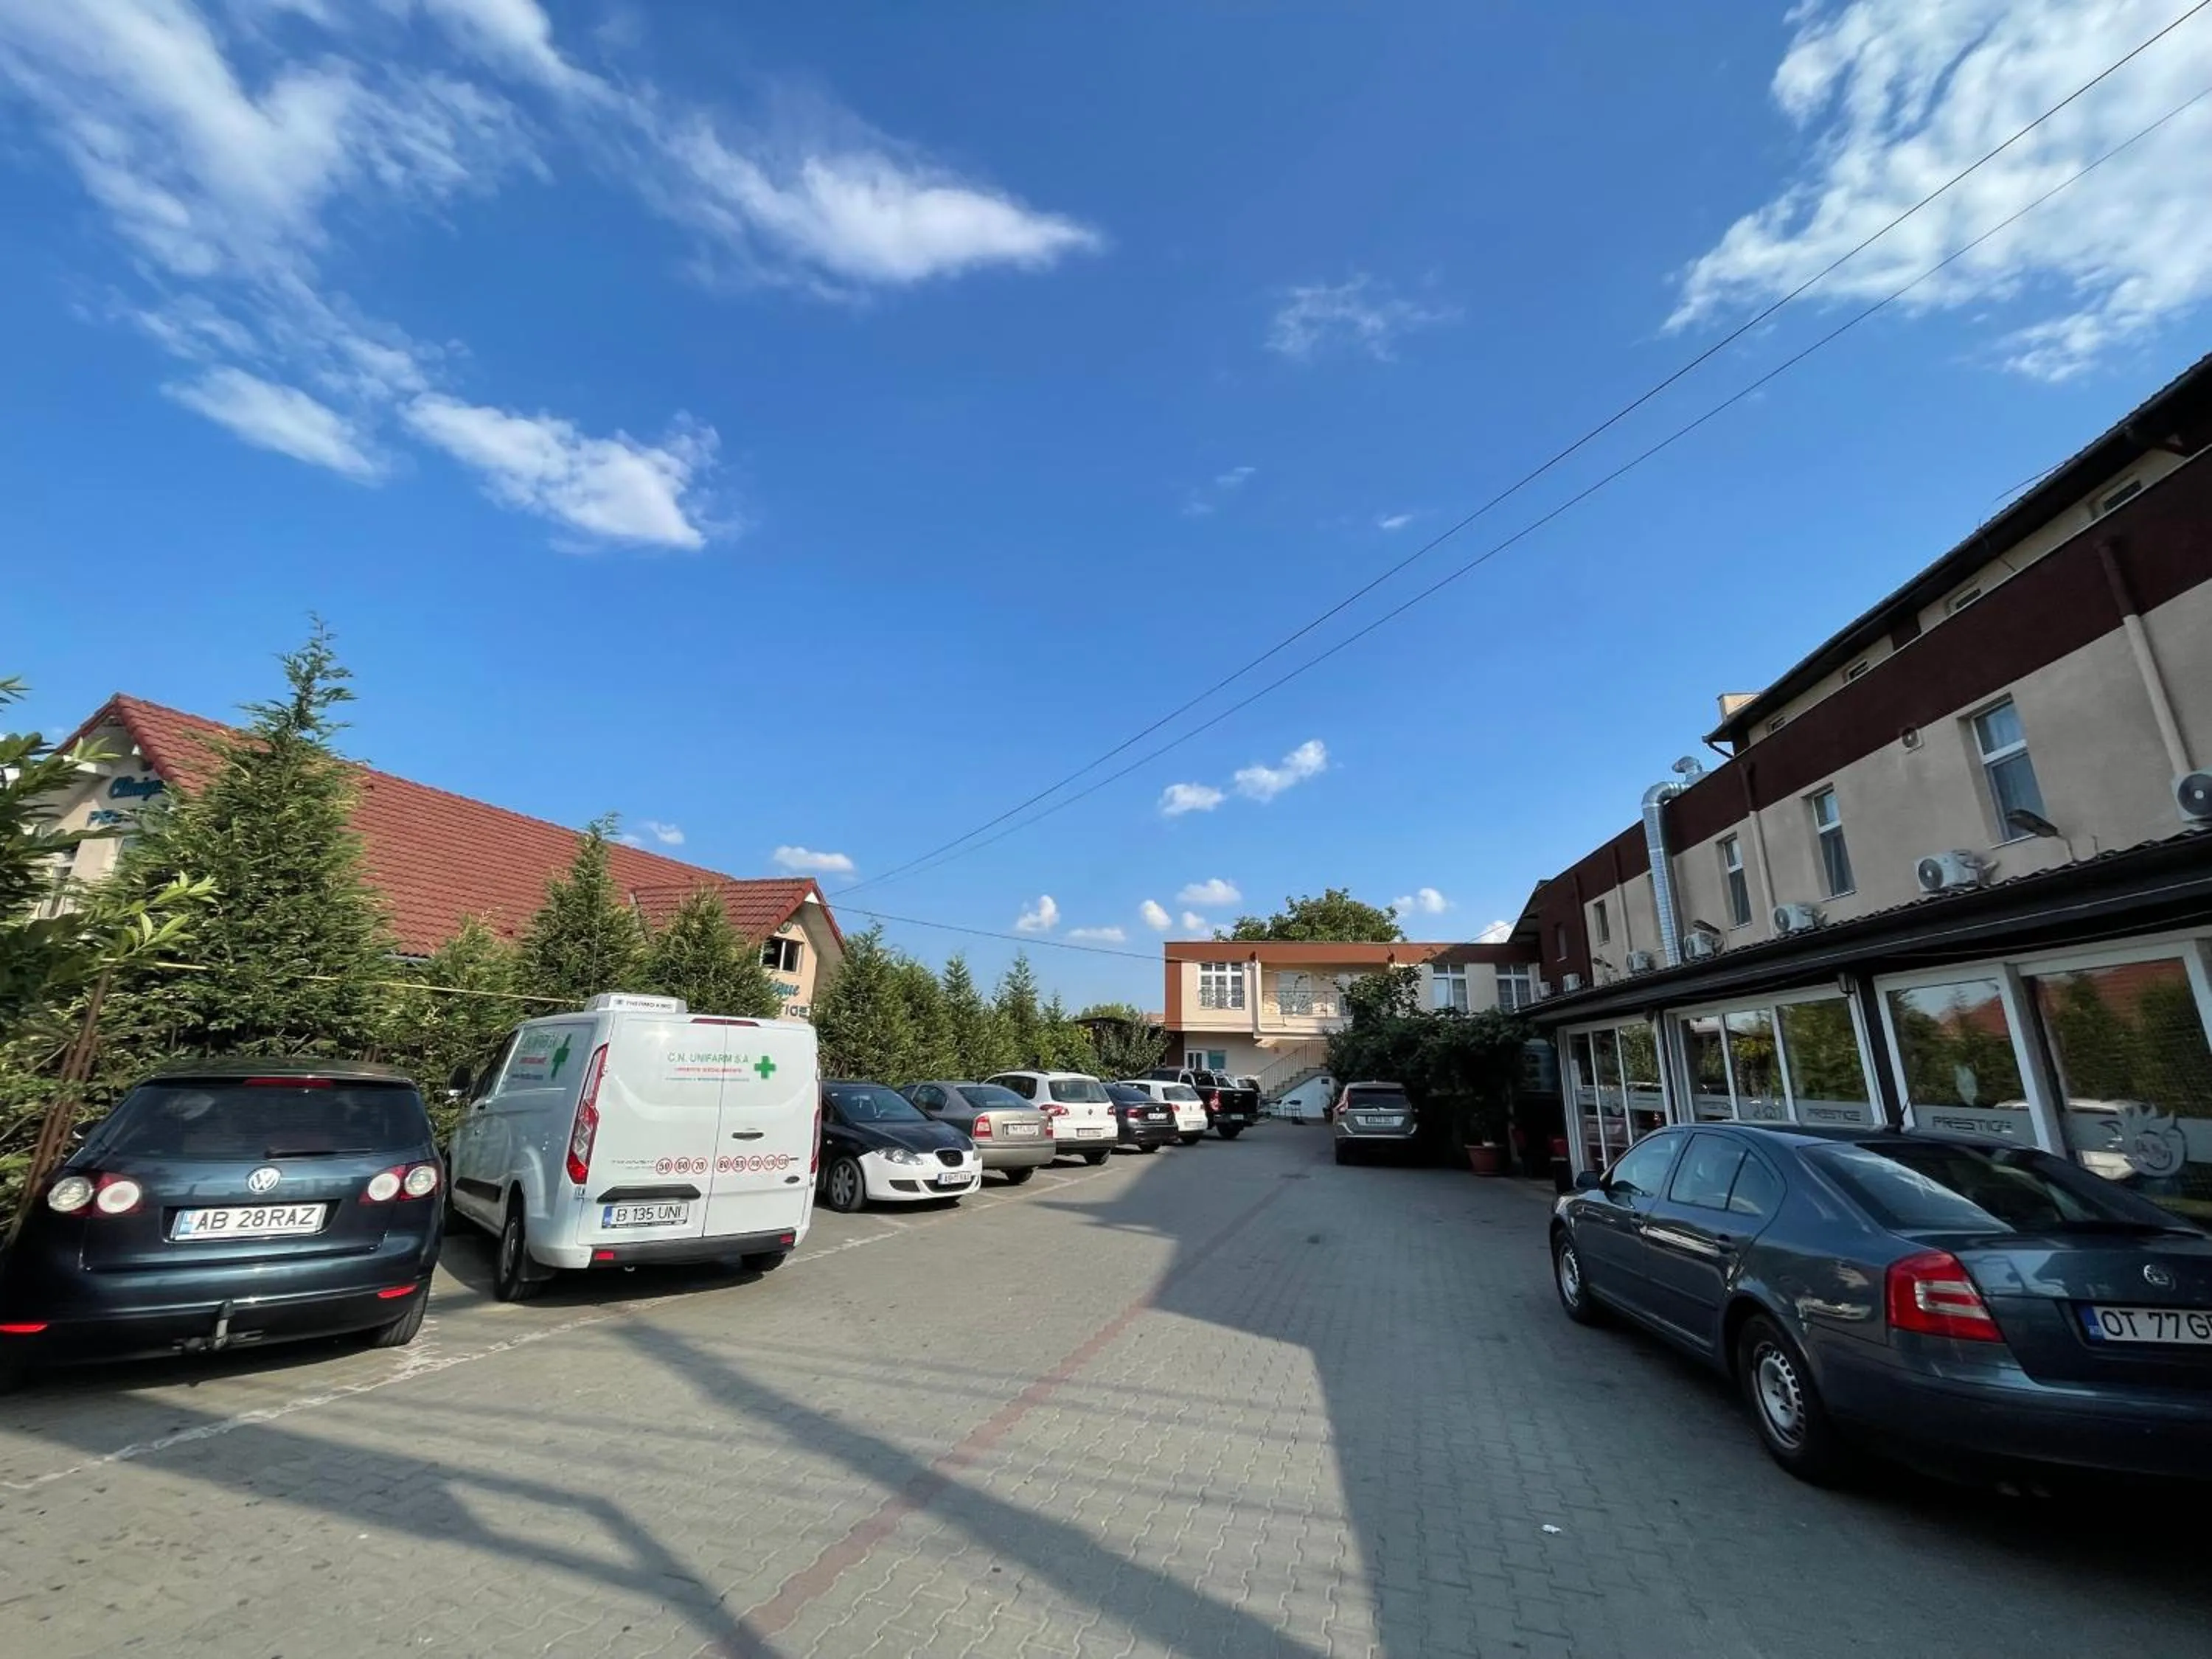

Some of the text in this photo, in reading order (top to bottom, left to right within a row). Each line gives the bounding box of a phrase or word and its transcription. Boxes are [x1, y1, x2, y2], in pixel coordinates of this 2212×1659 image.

[689, 1053, 732, 1063] UNIFARM
[195, 1211, 229, 1231] AB
[616, 1205, 682, 1222] B 135 UNI
[2101, 1310, 2138, 1337] OT
